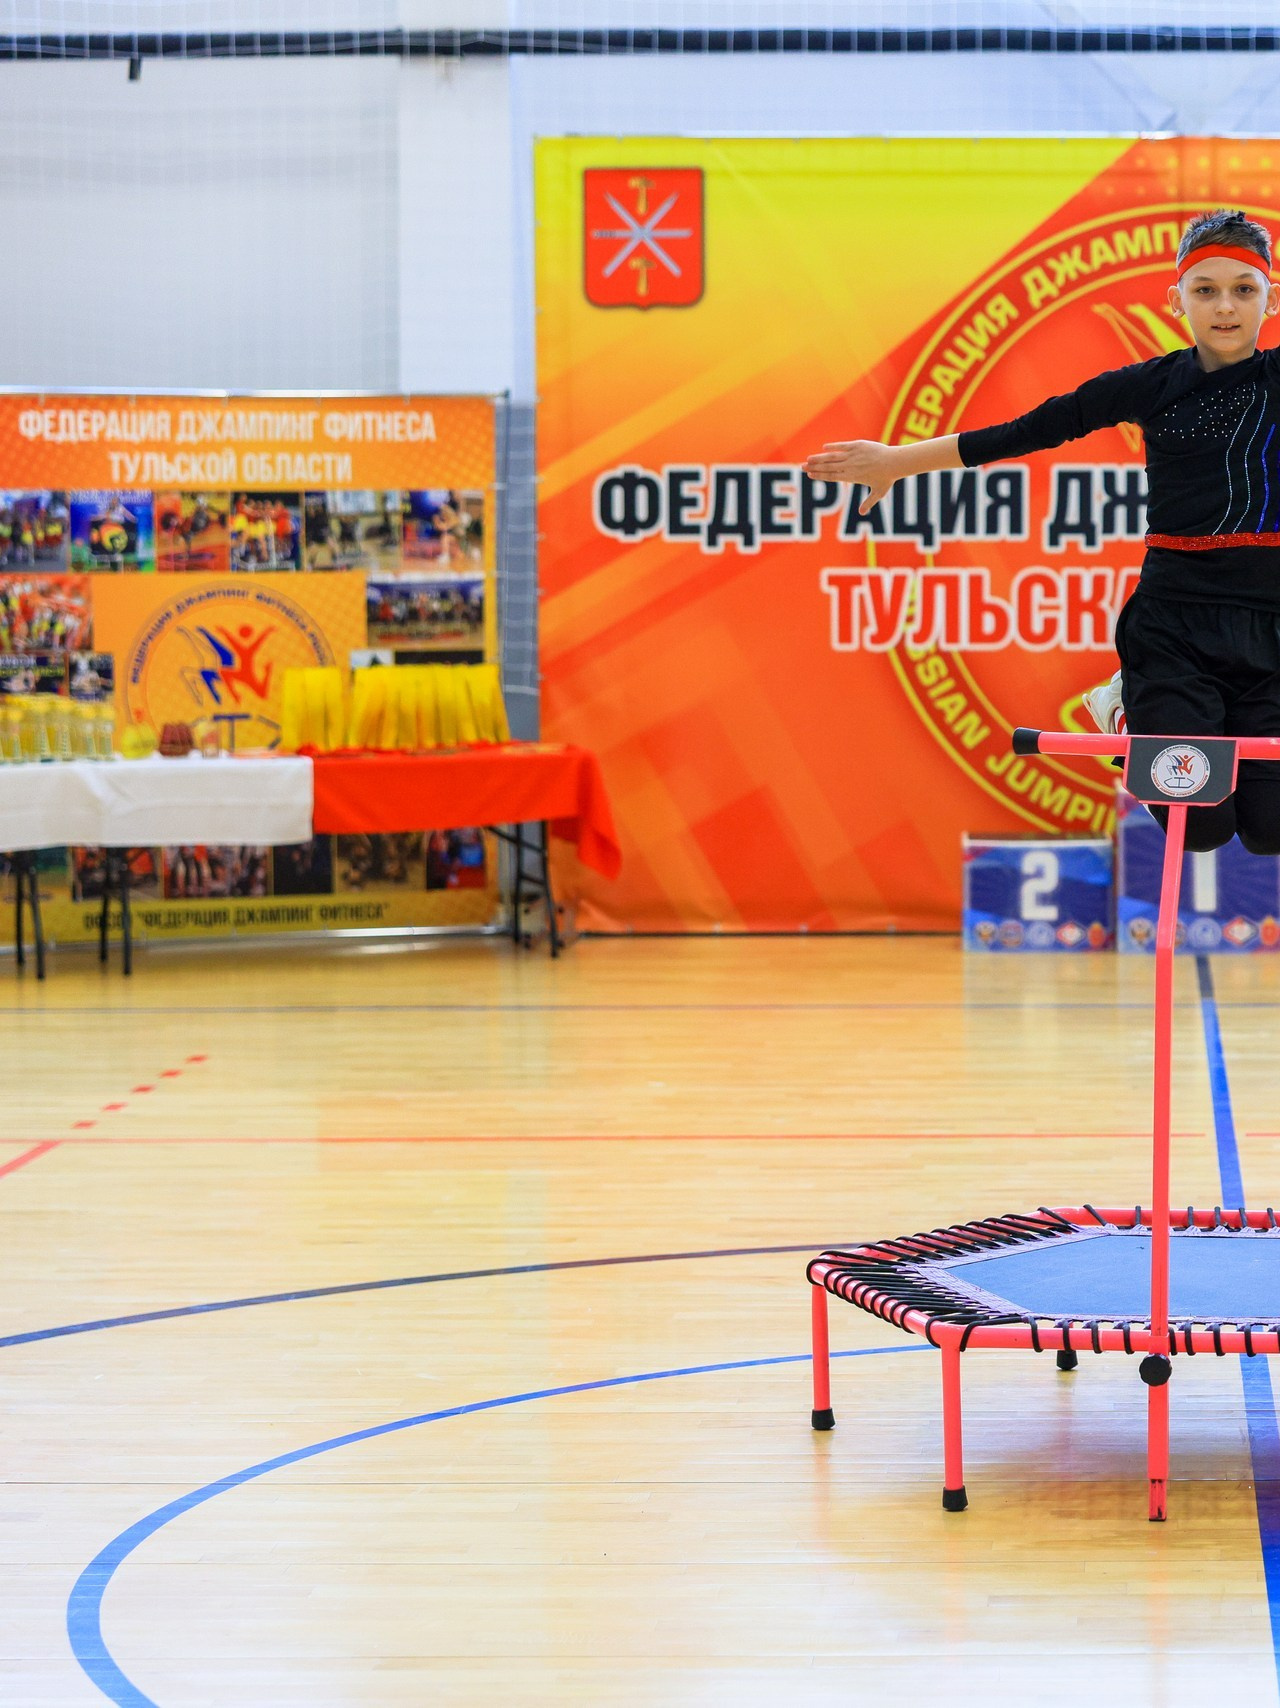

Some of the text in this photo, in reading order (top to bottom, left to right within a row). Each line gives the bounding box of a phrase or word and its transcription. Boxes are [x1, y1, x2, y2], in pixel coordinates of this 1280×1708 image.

[900, 292, 1019, 445] ЕРАЦИЯ
[1021, 221, 1188, 309] ДЖАМП
[18, 410, 437, 443] ФЕДЕРАЦИЯ ДЖАМПИНГ ФИТНЕСА
[109, 447, 352, 483] ТУЛЬСКОЙ ОБЛАСТИ
[599, 467, 1026, 550] ФЕДЕРАЦИЯ
[824, 568, 1138, 649] ТУЛЬСК
[985, 752, 1116, 834] JUMPI
[234, 905, 313, 926] ДЖАМПИНГ
[1020, 850, 1060, 921] 2
[1193, 849, 1217, 913] 1
